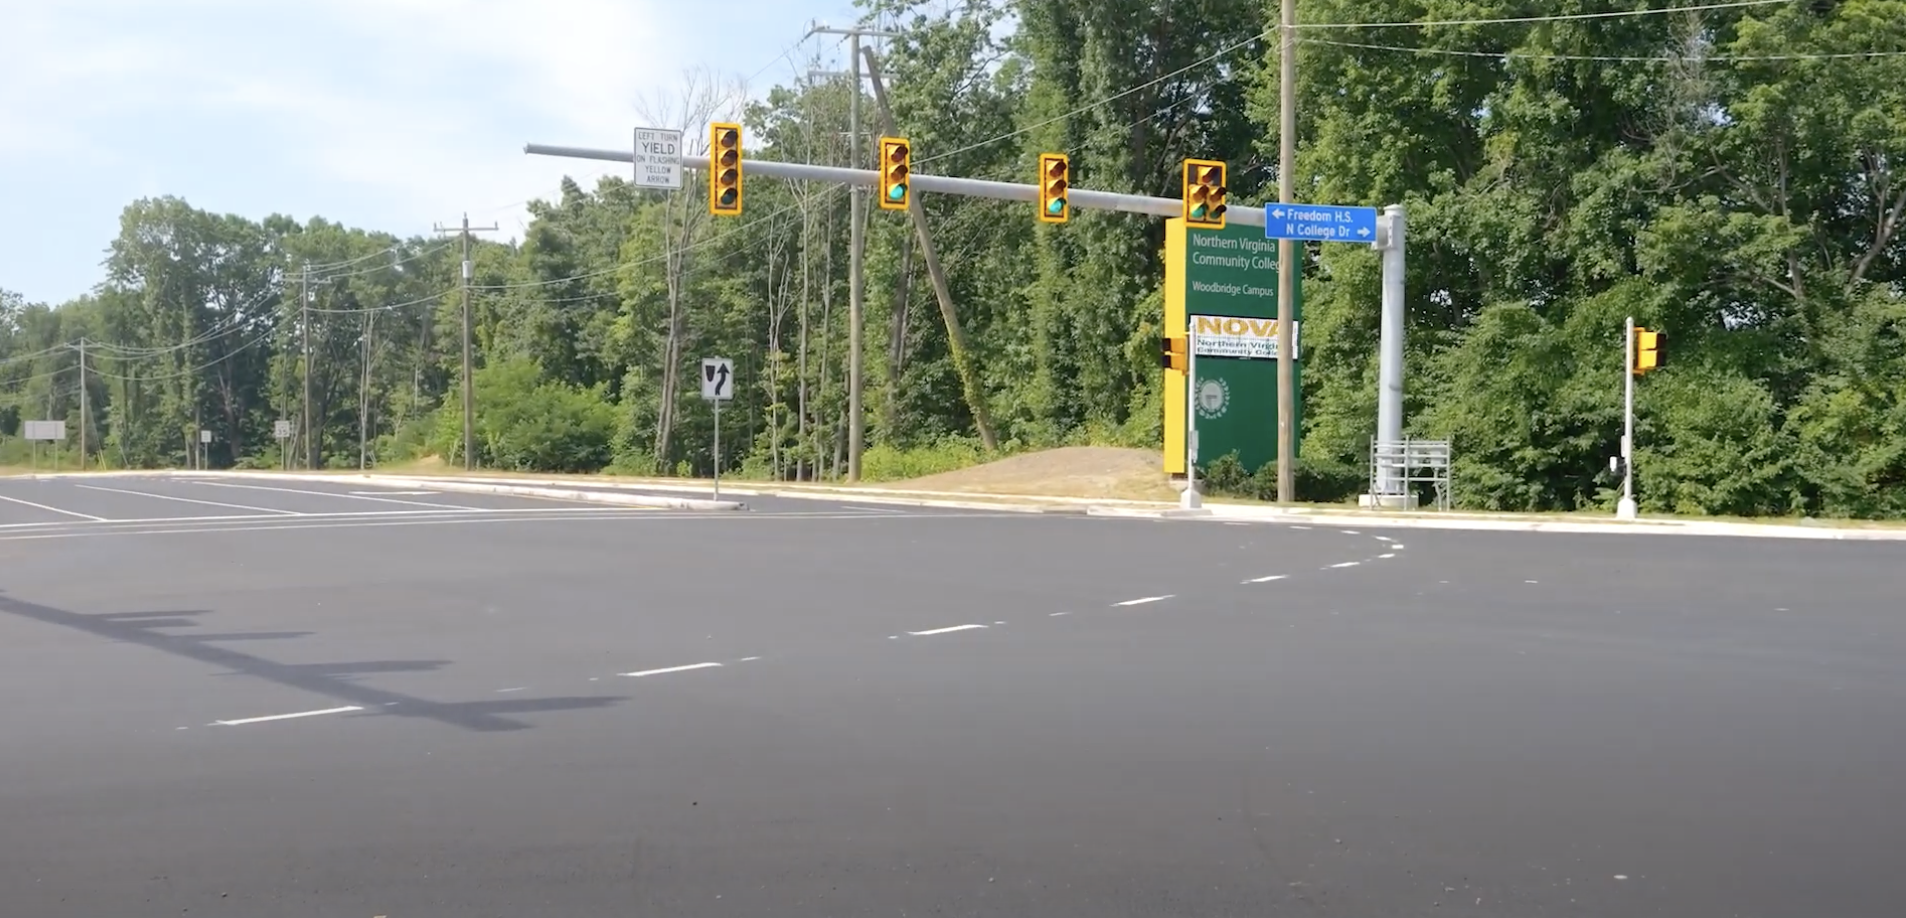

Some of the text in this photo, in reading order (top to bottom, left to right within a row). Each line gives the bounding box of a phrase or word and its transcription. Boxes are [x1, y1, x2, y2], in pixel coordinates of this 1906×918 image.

[638, 131, 678, 141] LEFT TURN
[641, 141, 675, 155] YIELD
[636, 155, 646, 163] ON
[645, 165, 671, 174] YELLOW
[1287, 208, 1353, 223] Freedom H.S.
[1286, 223, 1350, 240] N College Dr
[1193, 233, 1276, 254] Northern Virginia
[1192, 251, 1280, 274] Community Colleg
[1192, 281, 1274, 298] Woodbridge Campus
[1197, 339, 1247, 348] Northern
